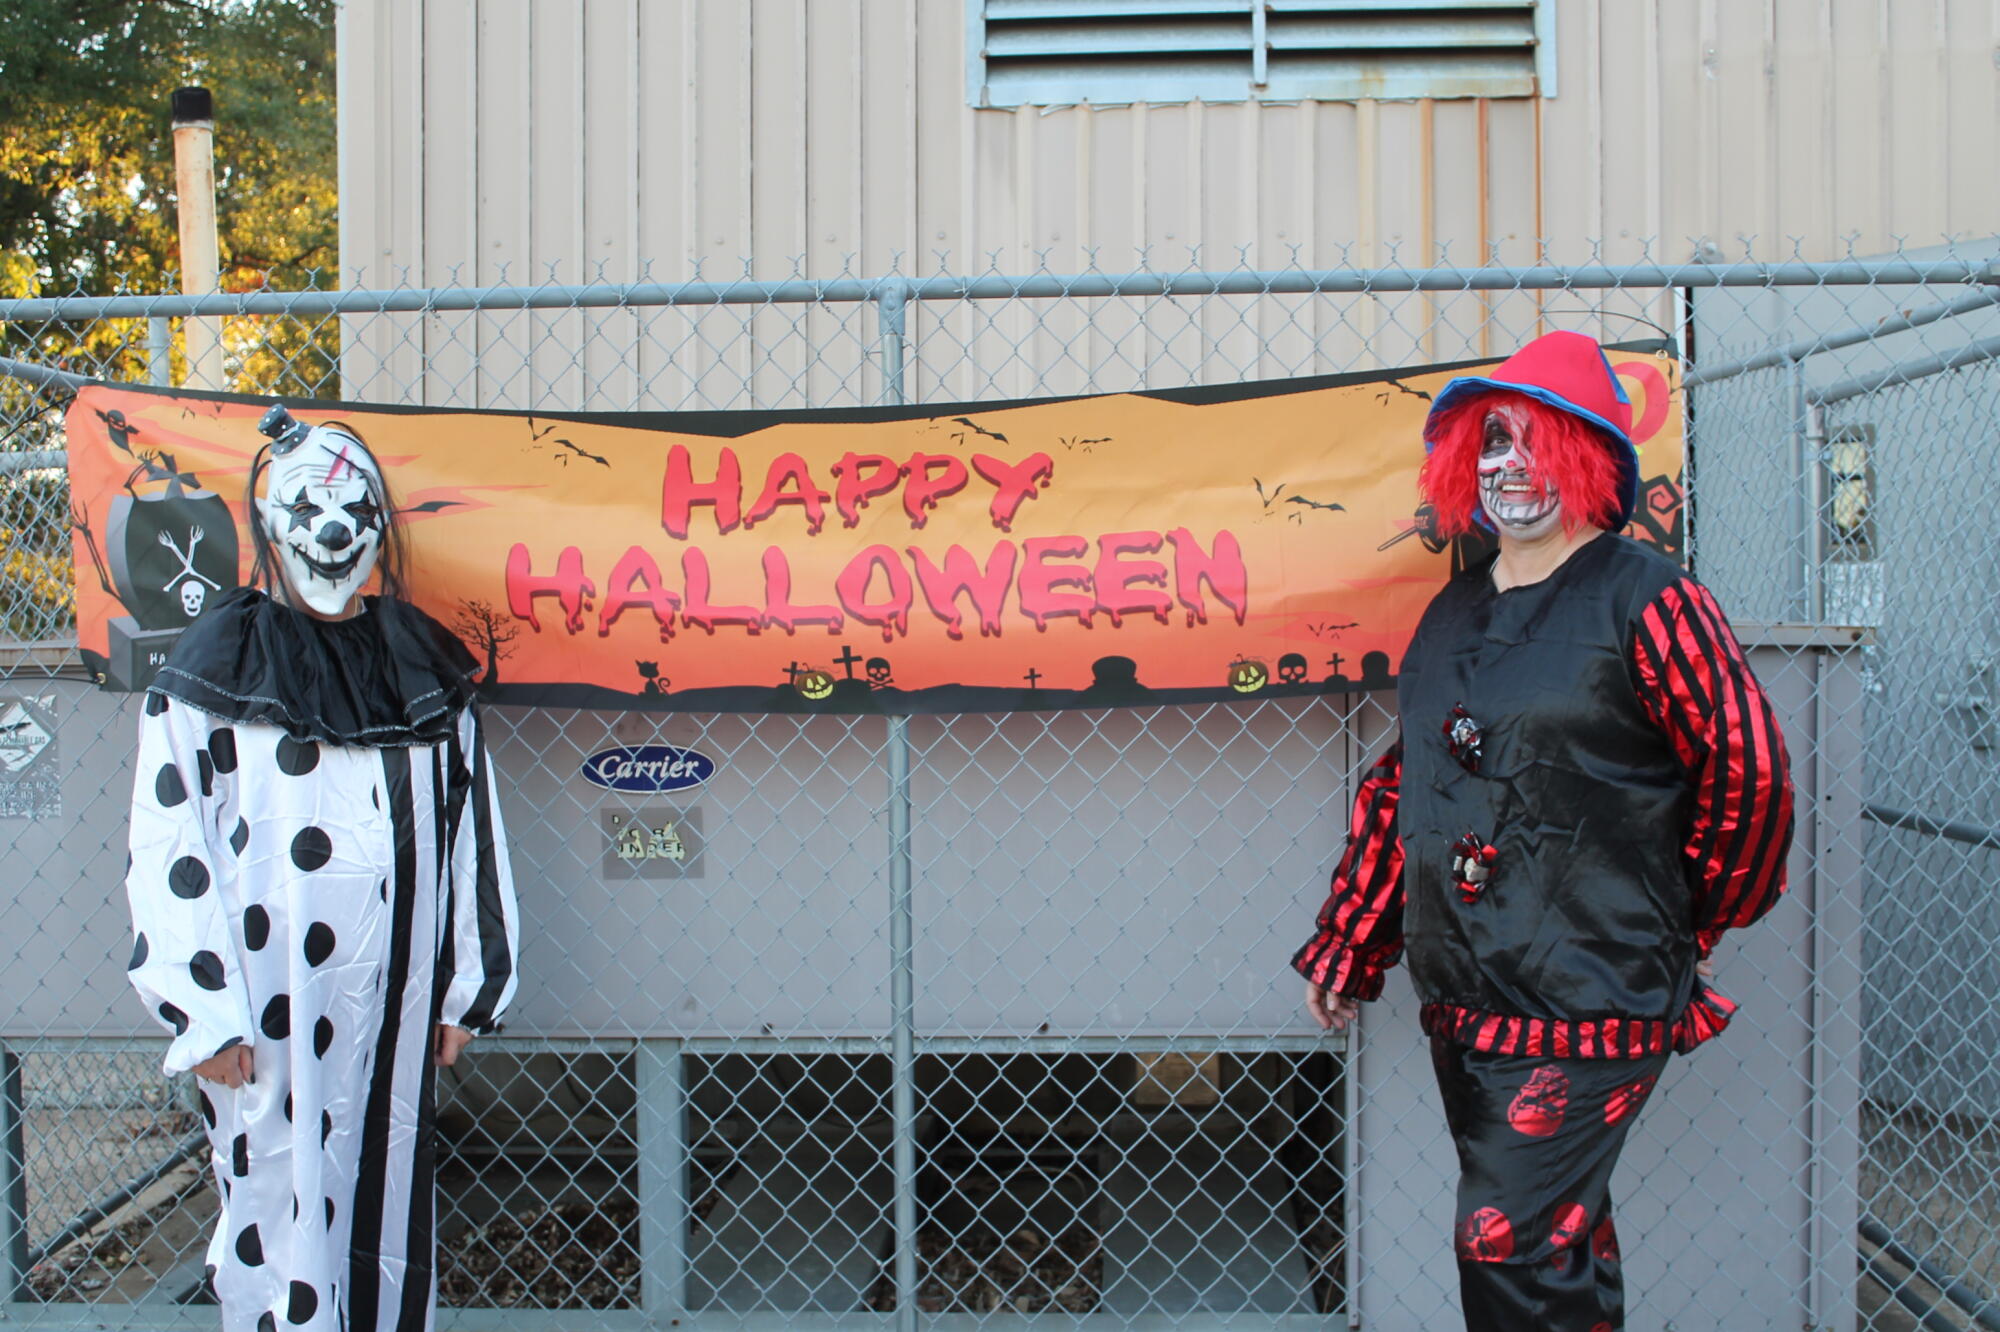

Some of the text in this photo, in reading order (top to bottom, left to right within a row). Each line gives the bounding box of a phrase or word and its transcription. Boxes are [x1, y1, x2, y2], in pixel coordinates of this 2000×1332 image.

[662, 444, 1054, 541] HAPPY
[505, 527, 1248, 644] HALLOWEEN
[597, 755, 699, 779] Carrier
